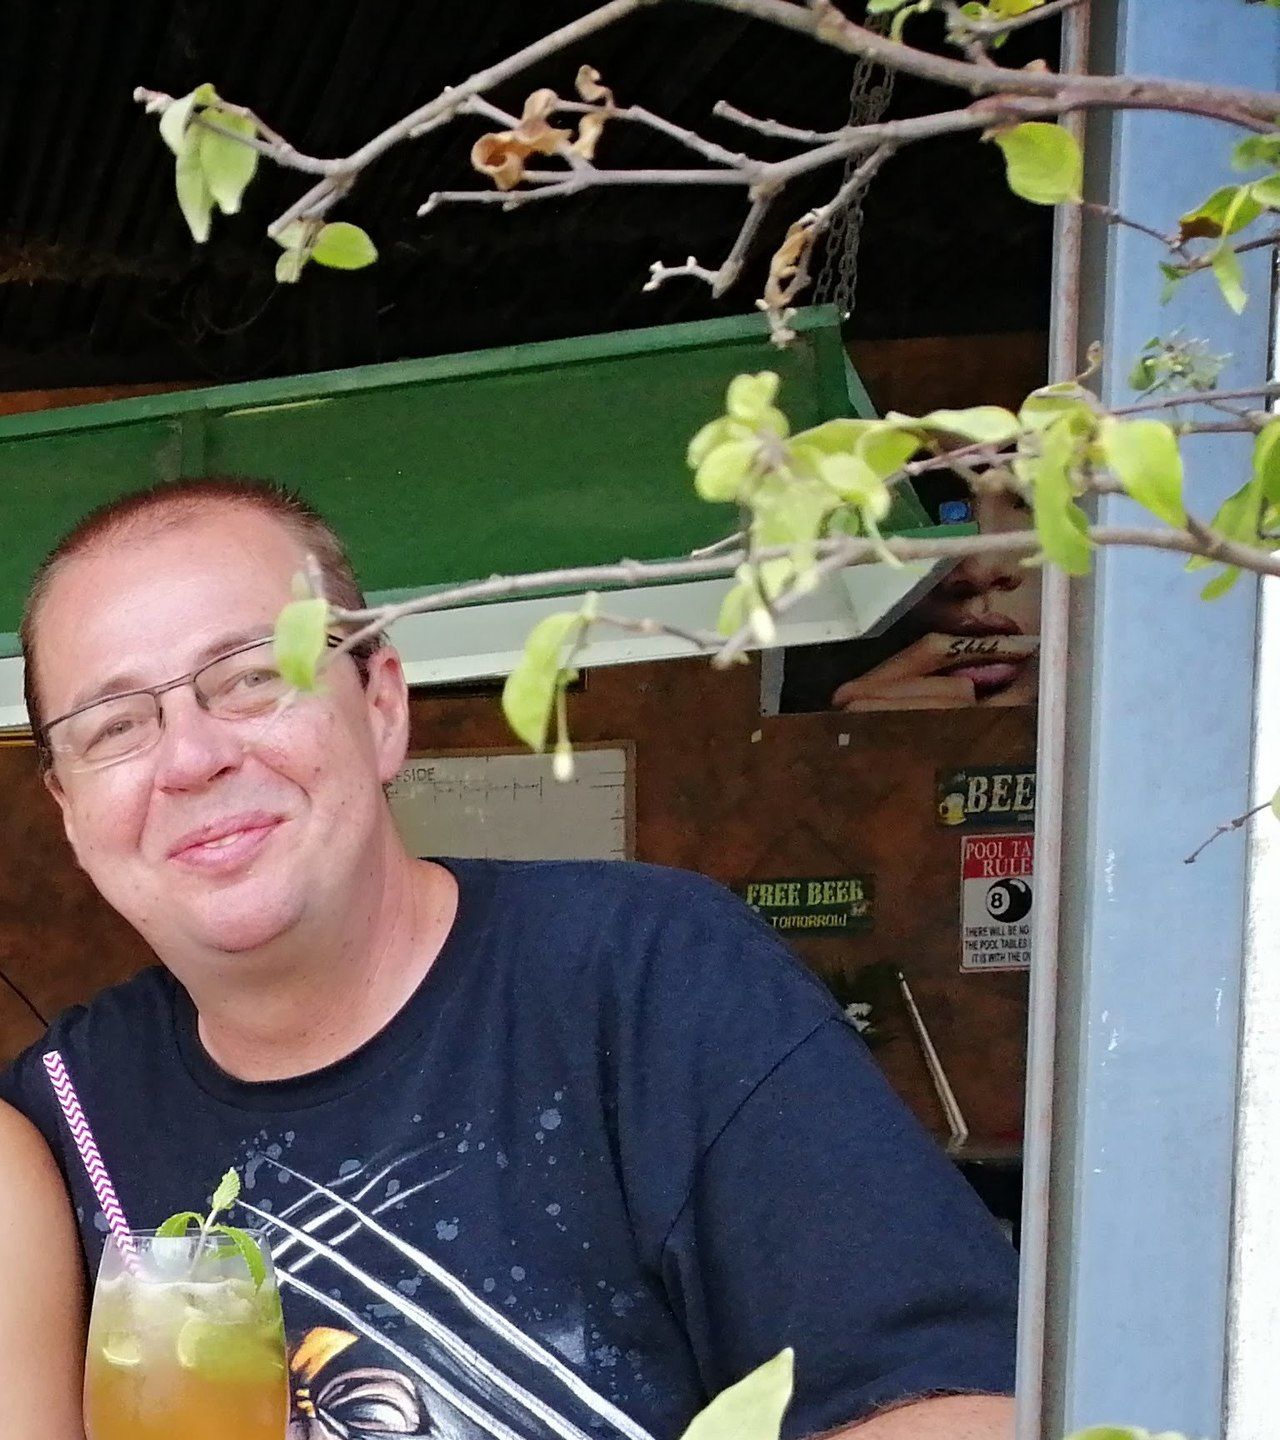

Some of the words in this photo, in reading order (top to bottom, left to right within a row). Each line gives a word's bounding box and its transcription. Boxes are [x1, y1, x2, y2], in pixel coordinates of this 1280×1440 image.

[966, 841, 1004, 860] POOL
[746, 882, 801, 907] FREE
[807, 880, 864, 906] BEER
[771, 913, 848, 929] TOMORROW
